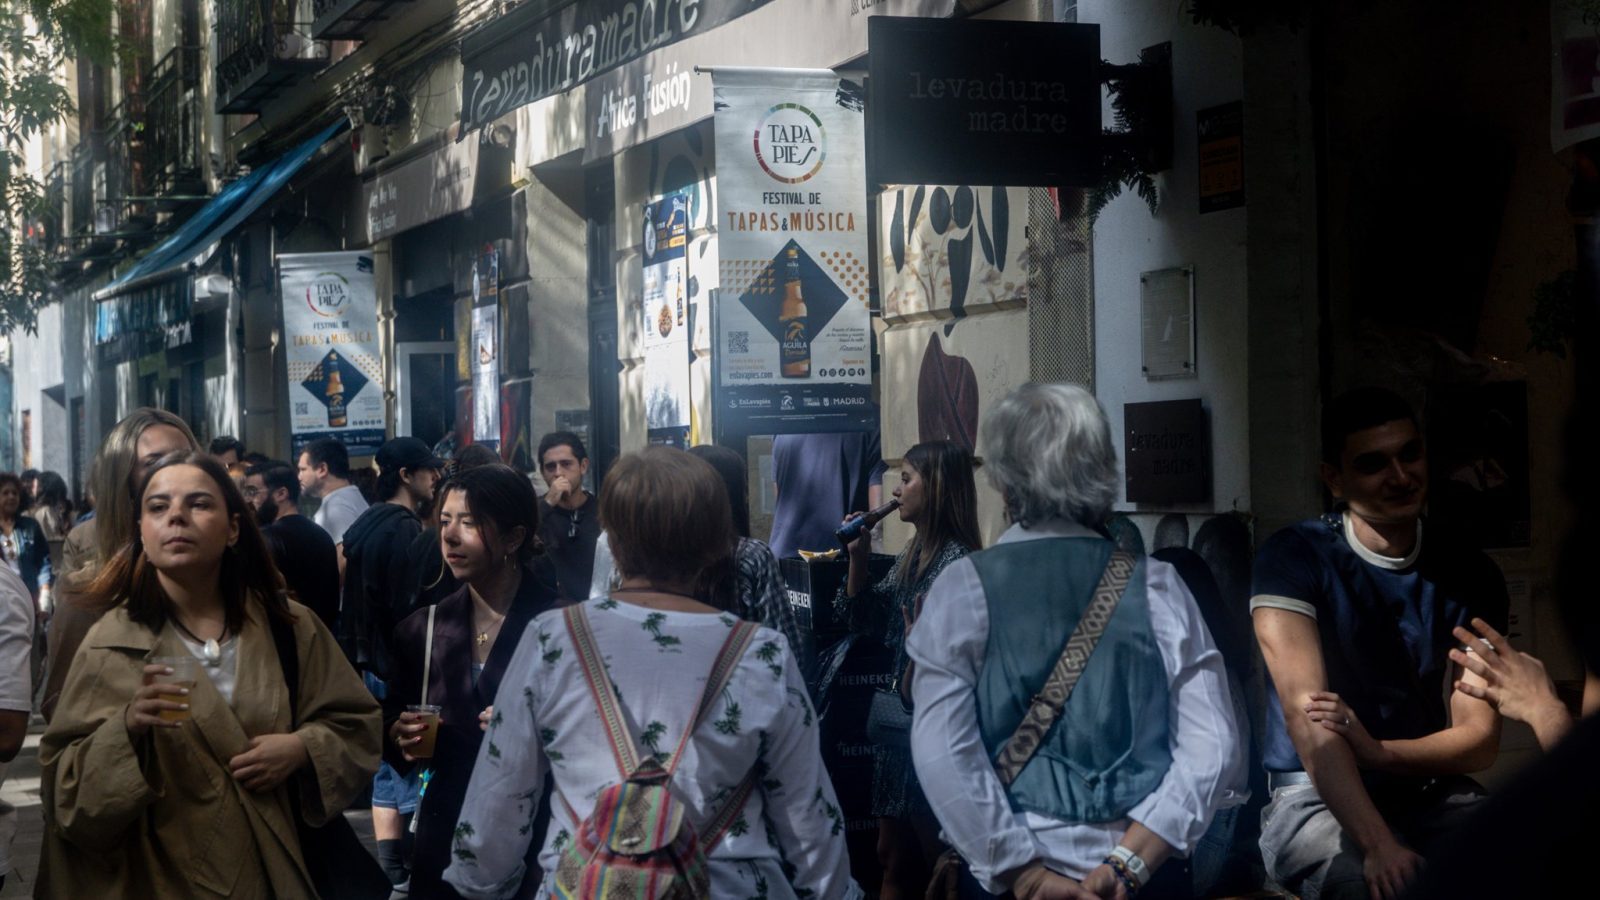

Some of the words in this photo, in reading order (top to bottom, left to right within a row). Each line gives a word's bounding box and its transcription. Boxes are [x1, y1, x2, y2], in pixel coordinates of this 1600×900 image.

[643, 60, 691, 120] Fusión
[909, 71, 1070, 104] levadura
[968, 104, 1069, 134] madre
[767, 124, 815, 144] TAPA
[763, 192, 805, 205] FESTIVAL
[809, 192, 821, 204] DE
[317, 283, 344, 295] TAPA
[833, 397, 866, 406] MADRID
[839, 673, 893, 687] HEINEKE
